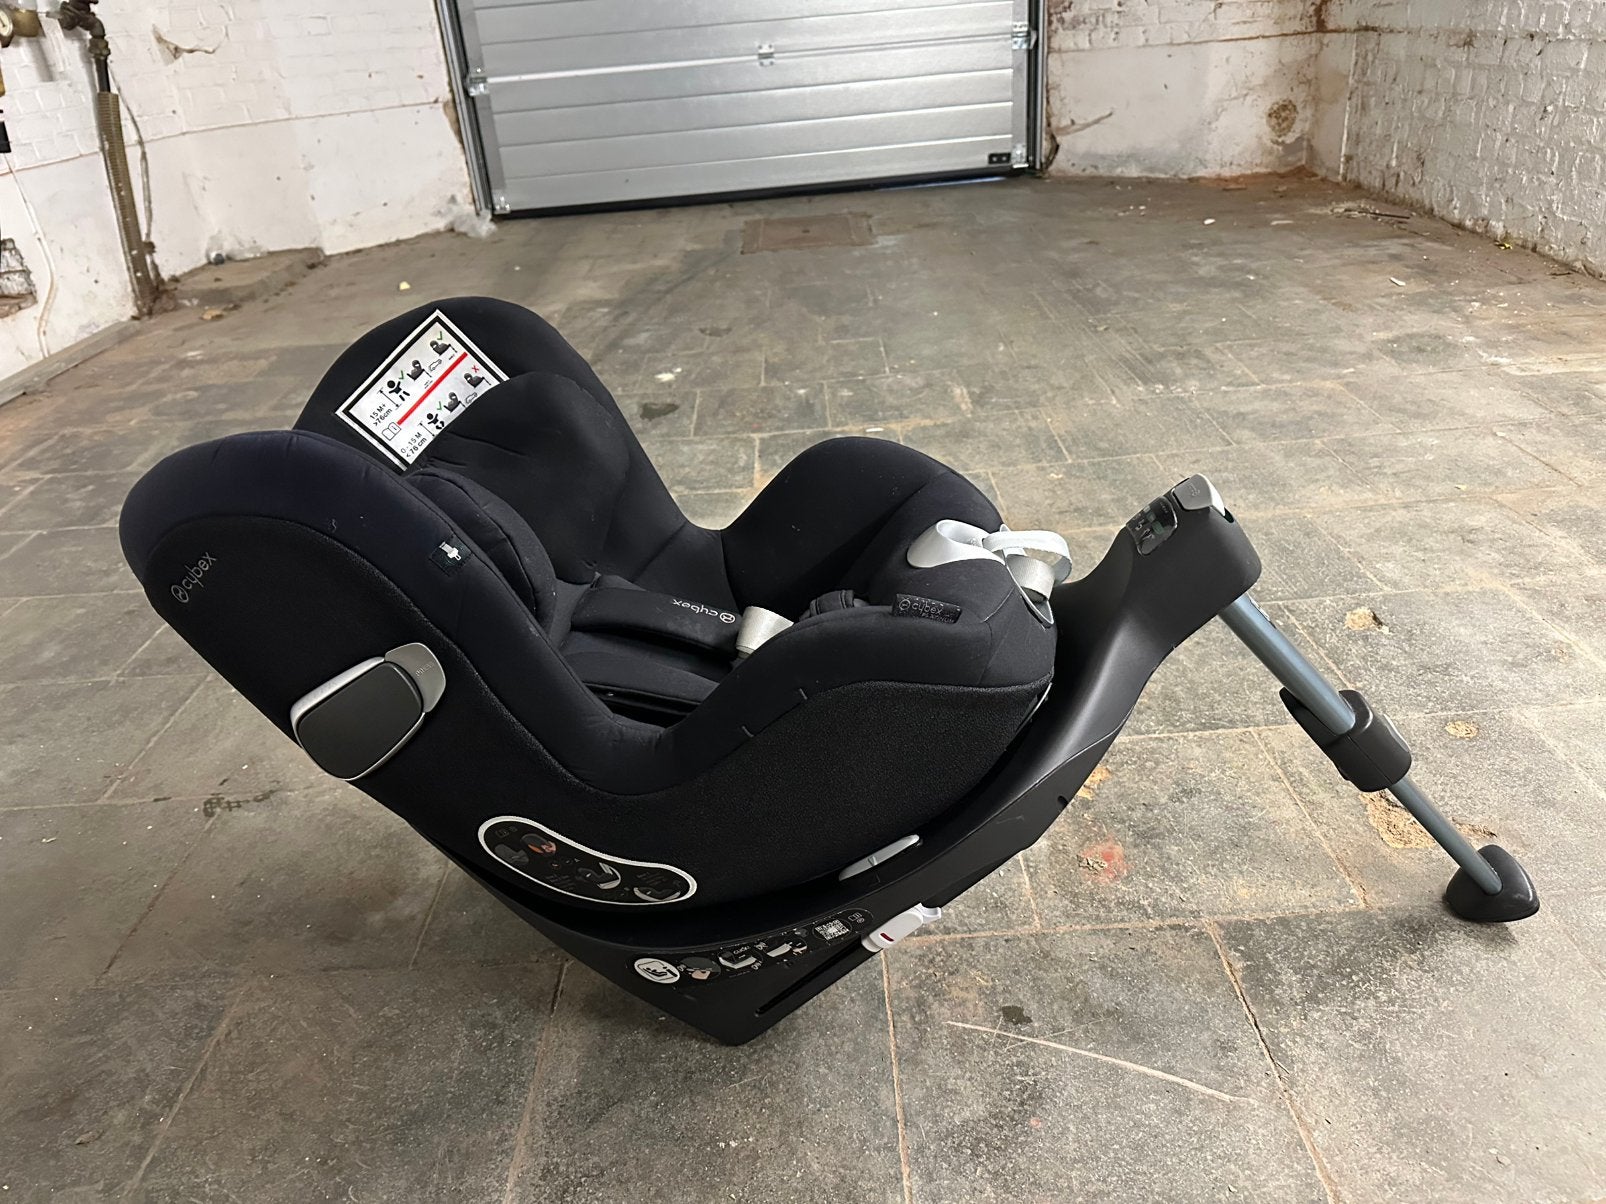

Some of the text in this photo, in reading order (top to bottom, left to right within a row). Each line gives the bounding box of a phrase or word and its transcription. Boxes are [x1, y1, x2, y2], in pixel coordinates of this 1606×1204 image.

[370, 411, 379, 419] 15
[418, 437, 427, 447] cm
[182, 552, 217, 589] cybex
[673, 598, 718, 616] cybex
[912, 601, 943, 614] cybex
